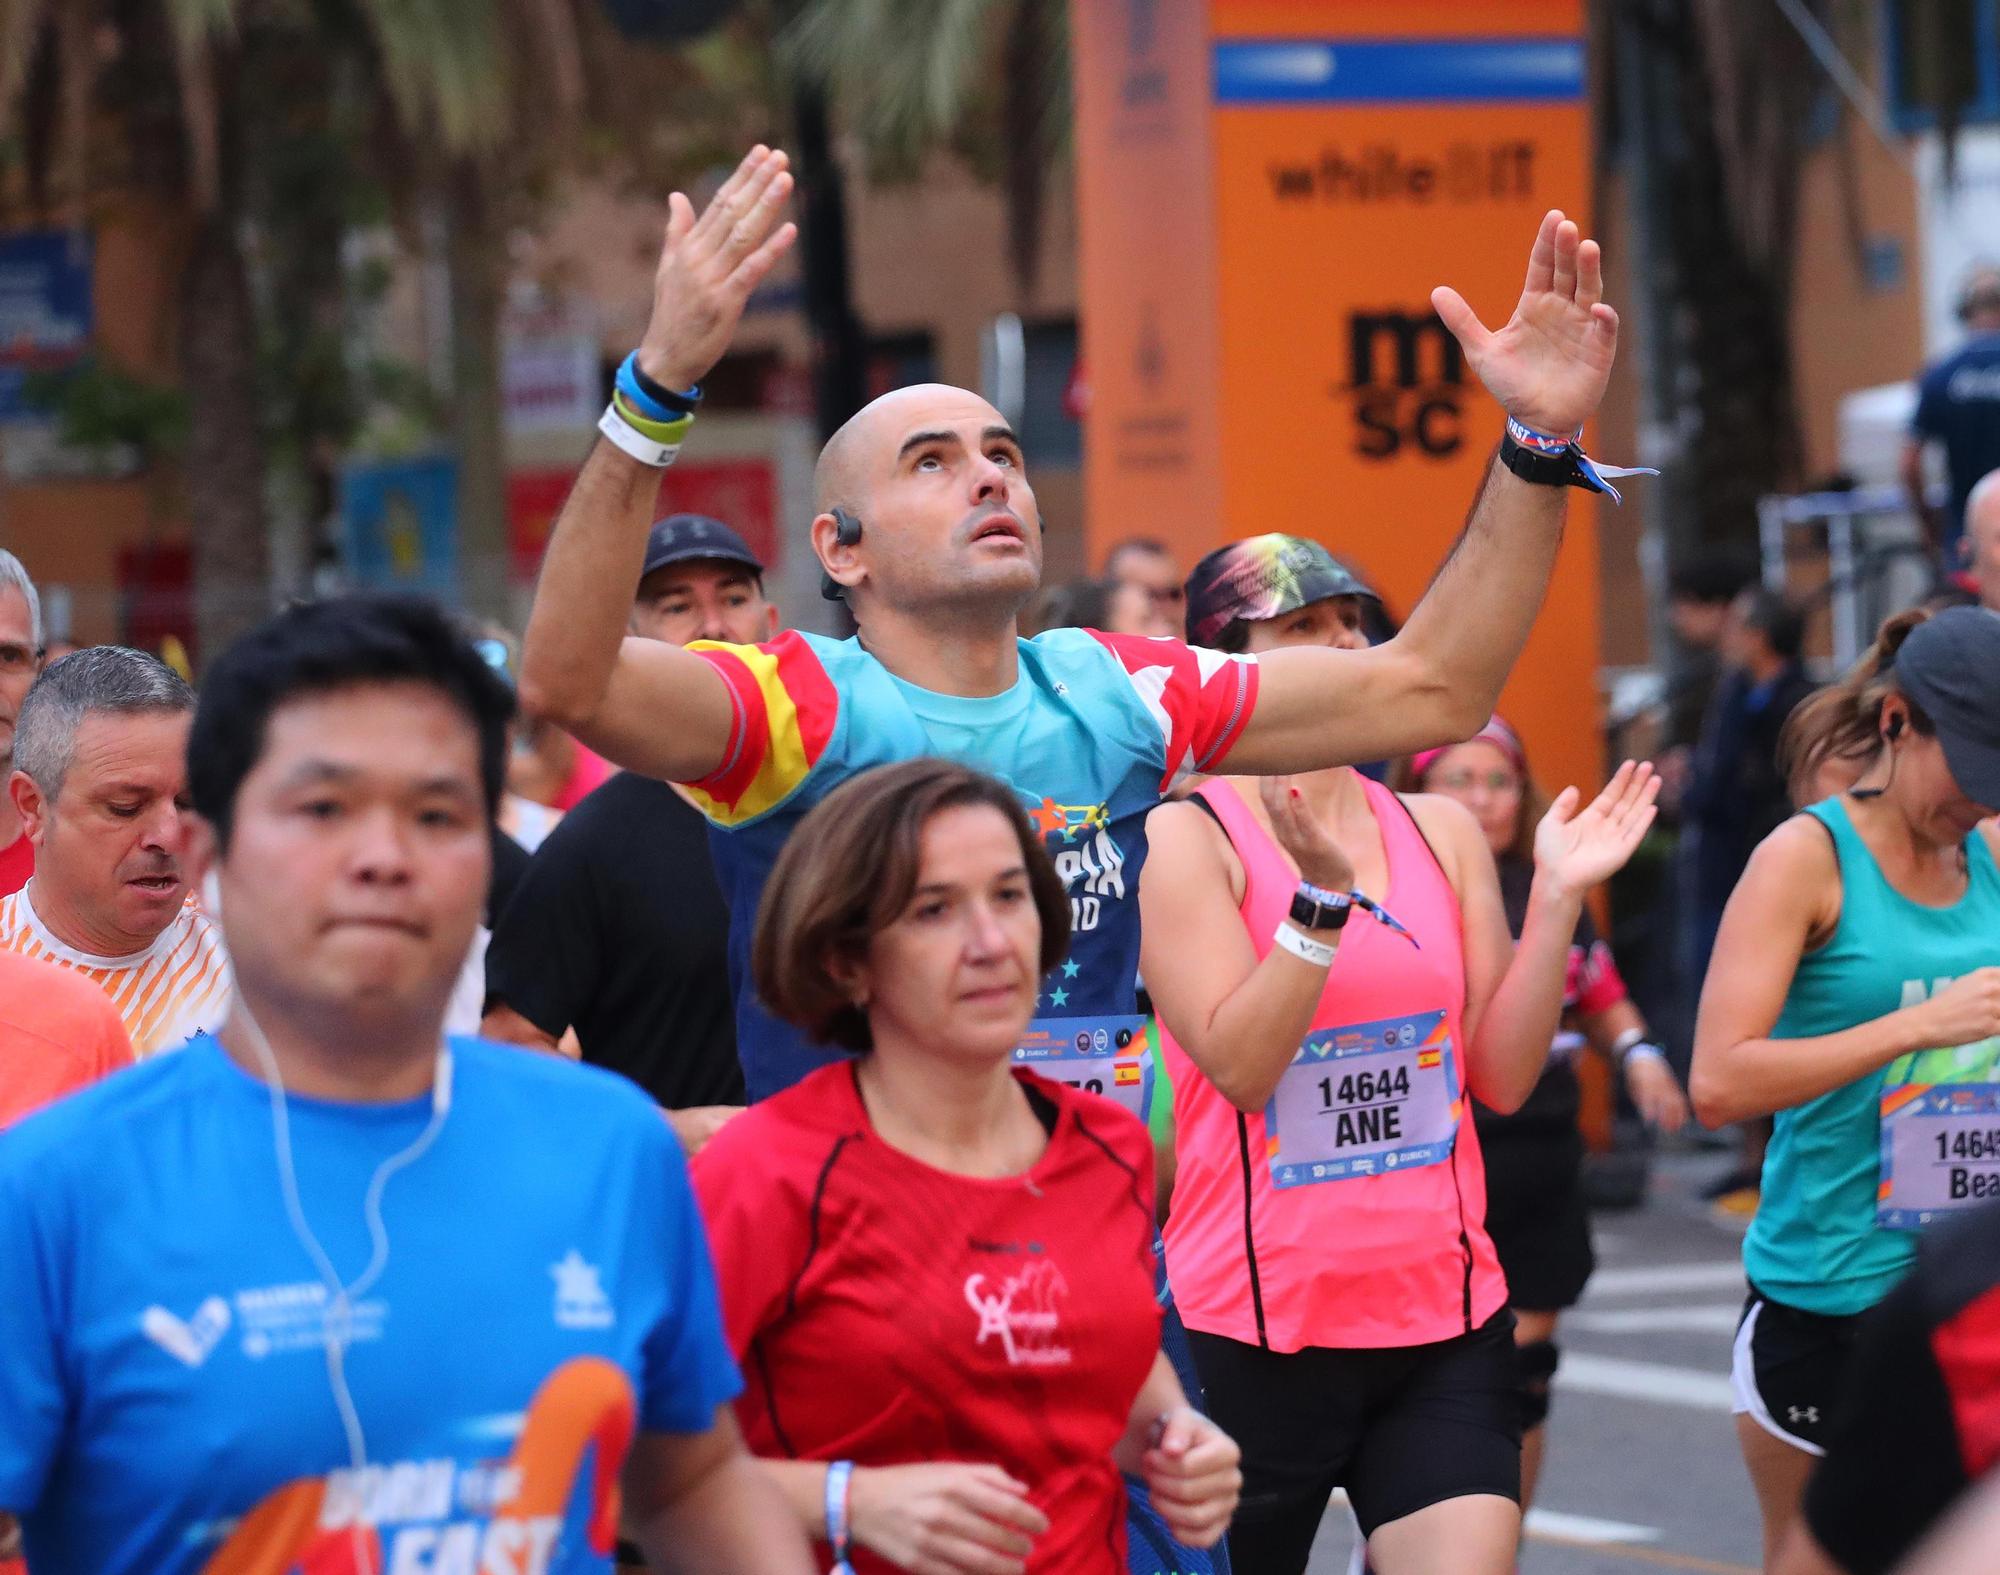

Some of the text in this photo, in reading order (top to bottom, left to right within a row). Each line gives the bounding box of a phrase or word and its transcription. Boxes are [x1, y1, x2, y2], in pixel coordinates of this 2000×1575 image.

[1509, 417, 1530, 442] FAST
[1055, 828, 1125, 899] PIA
[1318, 1066, 1410, 1107] 14644
[1335, 1106, 1402, 1148] ANE
